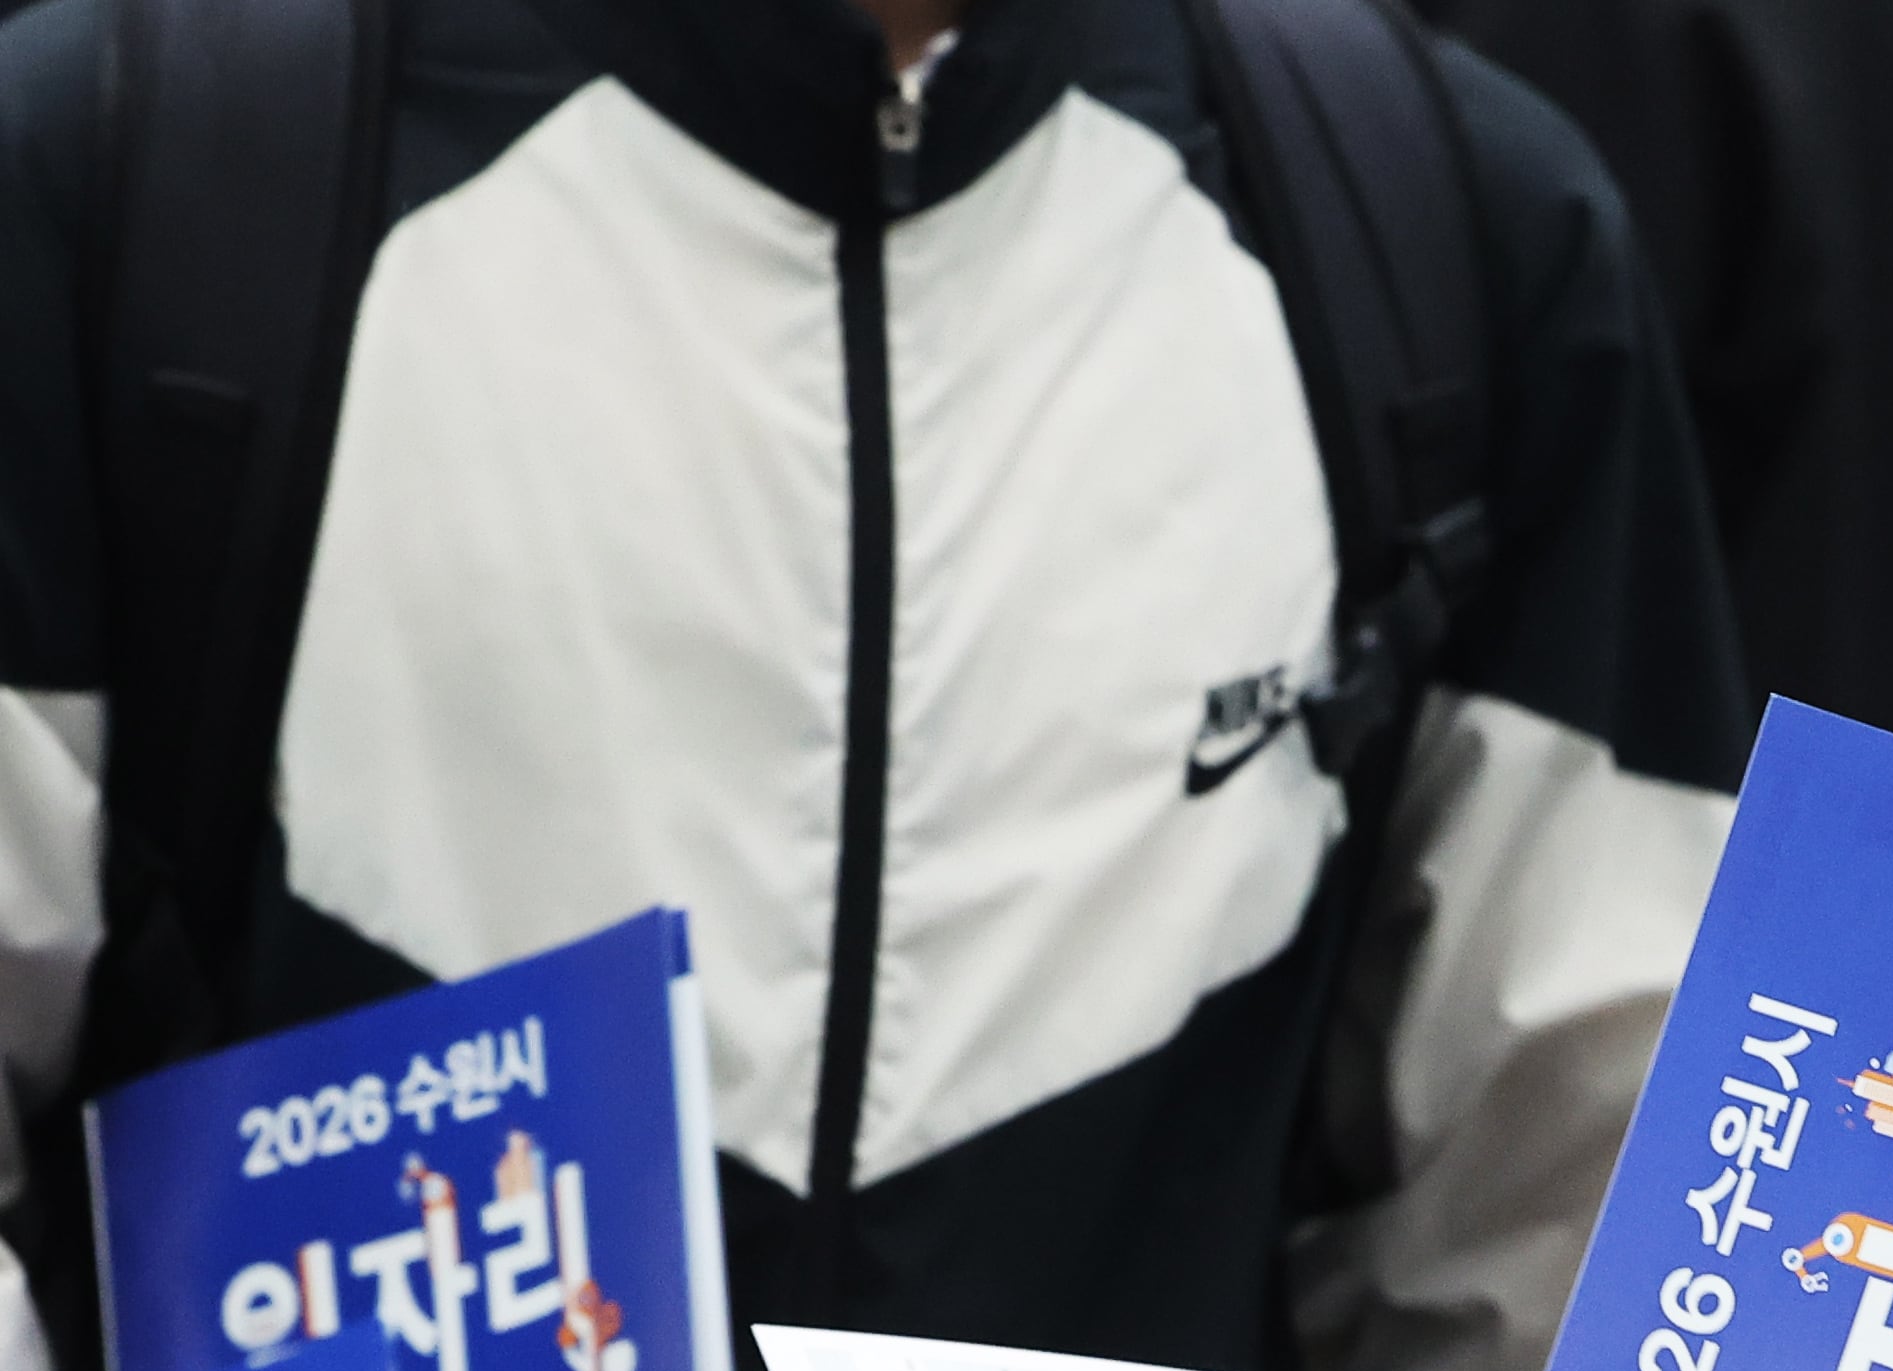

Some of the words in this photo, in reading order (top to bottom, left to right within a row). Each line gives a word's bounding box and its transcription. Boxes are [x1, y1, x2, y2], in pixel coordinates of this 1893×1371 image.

[239, 1076, 391, 1179] 2026
[396, 1016, 548, 1135] 수원시
[1685, 993, 1838, 1256] 수원시
